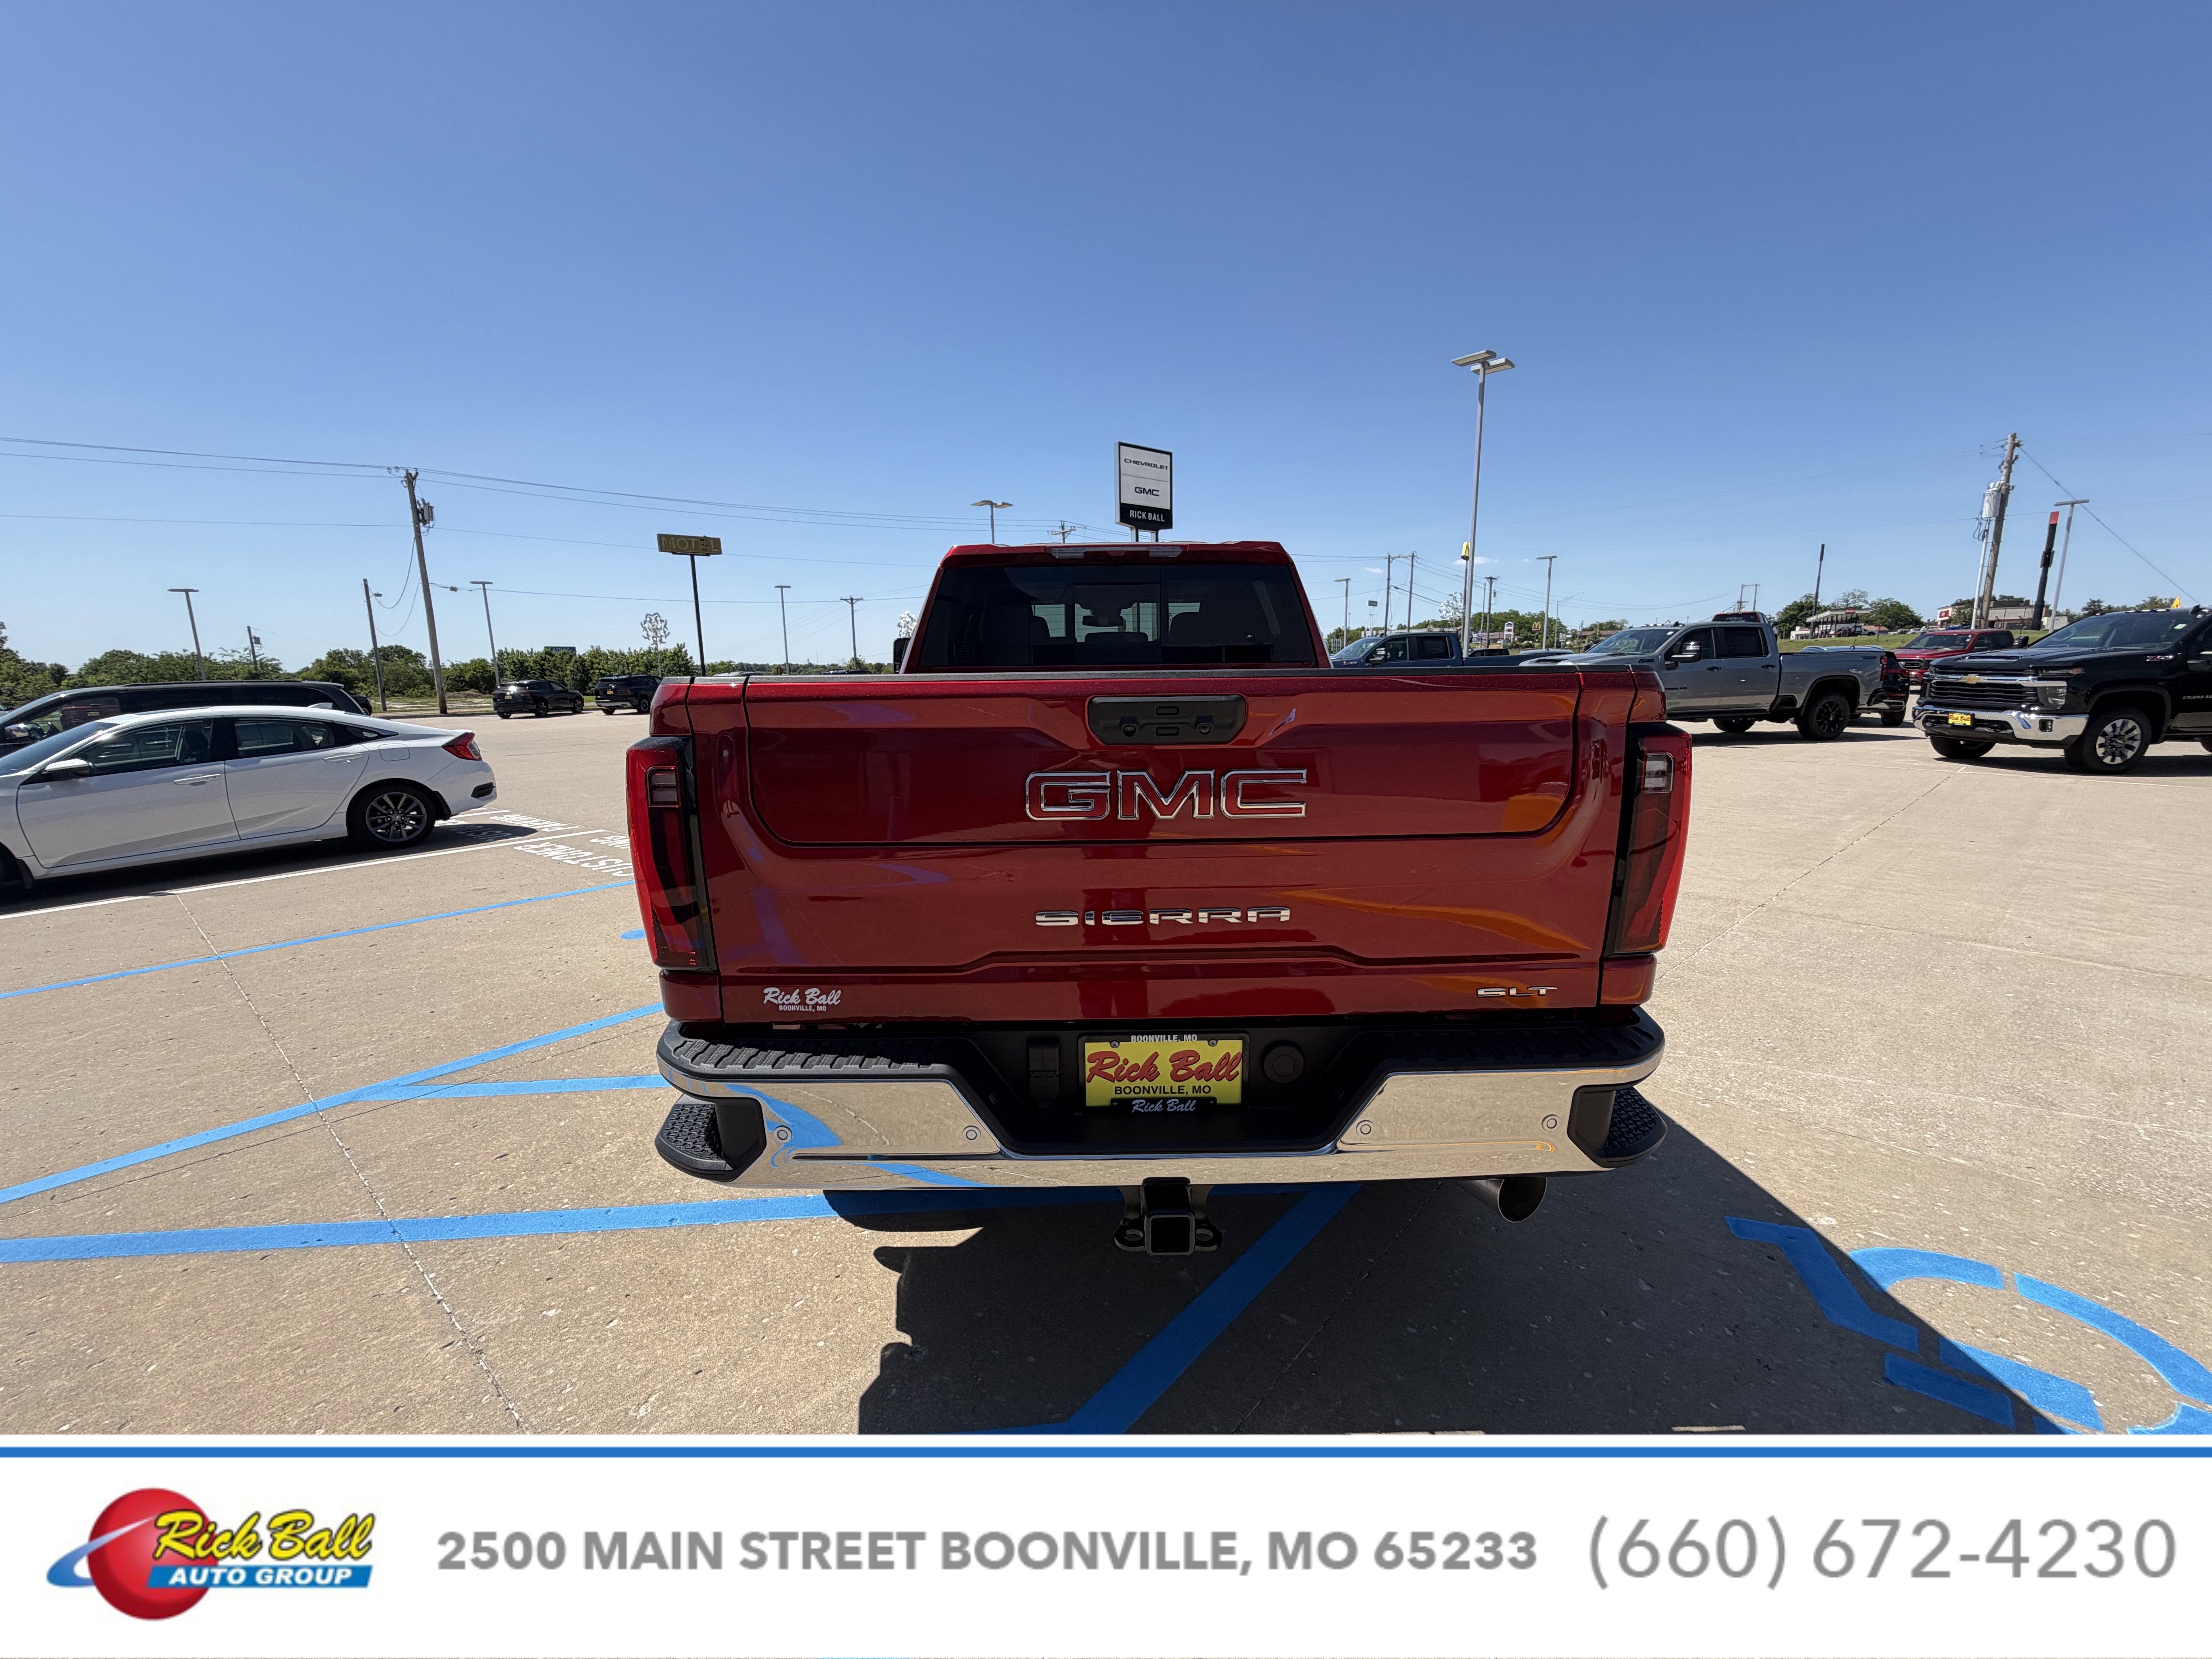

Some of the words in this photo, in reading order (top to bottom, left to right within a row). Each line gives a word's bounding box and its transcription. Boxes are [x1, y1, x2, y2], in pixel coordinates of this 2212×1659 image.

[1124, 458, 1169, 470] CHEVROLET
[1134, 486, 1160, 497] GMC
[1130, 510, 1147, 520] RICK
[1148, 512, 1165, 522] BALL
[1025, 768, 1307, 821] GMC
[1035, 907, 1290, 926] SIERRA
[763, 987, 801, 1004] Rick
[804, 988, 841, 1005] Ball
[1477, 986, 1558, 998] SLT
[1131, 1034, 1181, 1042] BOONVILLE,
[1086, 1051, 1160, 1083] Rick
[1168, 1049, 1242, 1082] Ball
[1115, 1085, 1188, 1096] BOONVILLE,
[1192, 1085, 1211, 1094] MO
[1131, 1099, 1163, 1113] Rick
[1166, 1098, 1196, 1112] Ball
